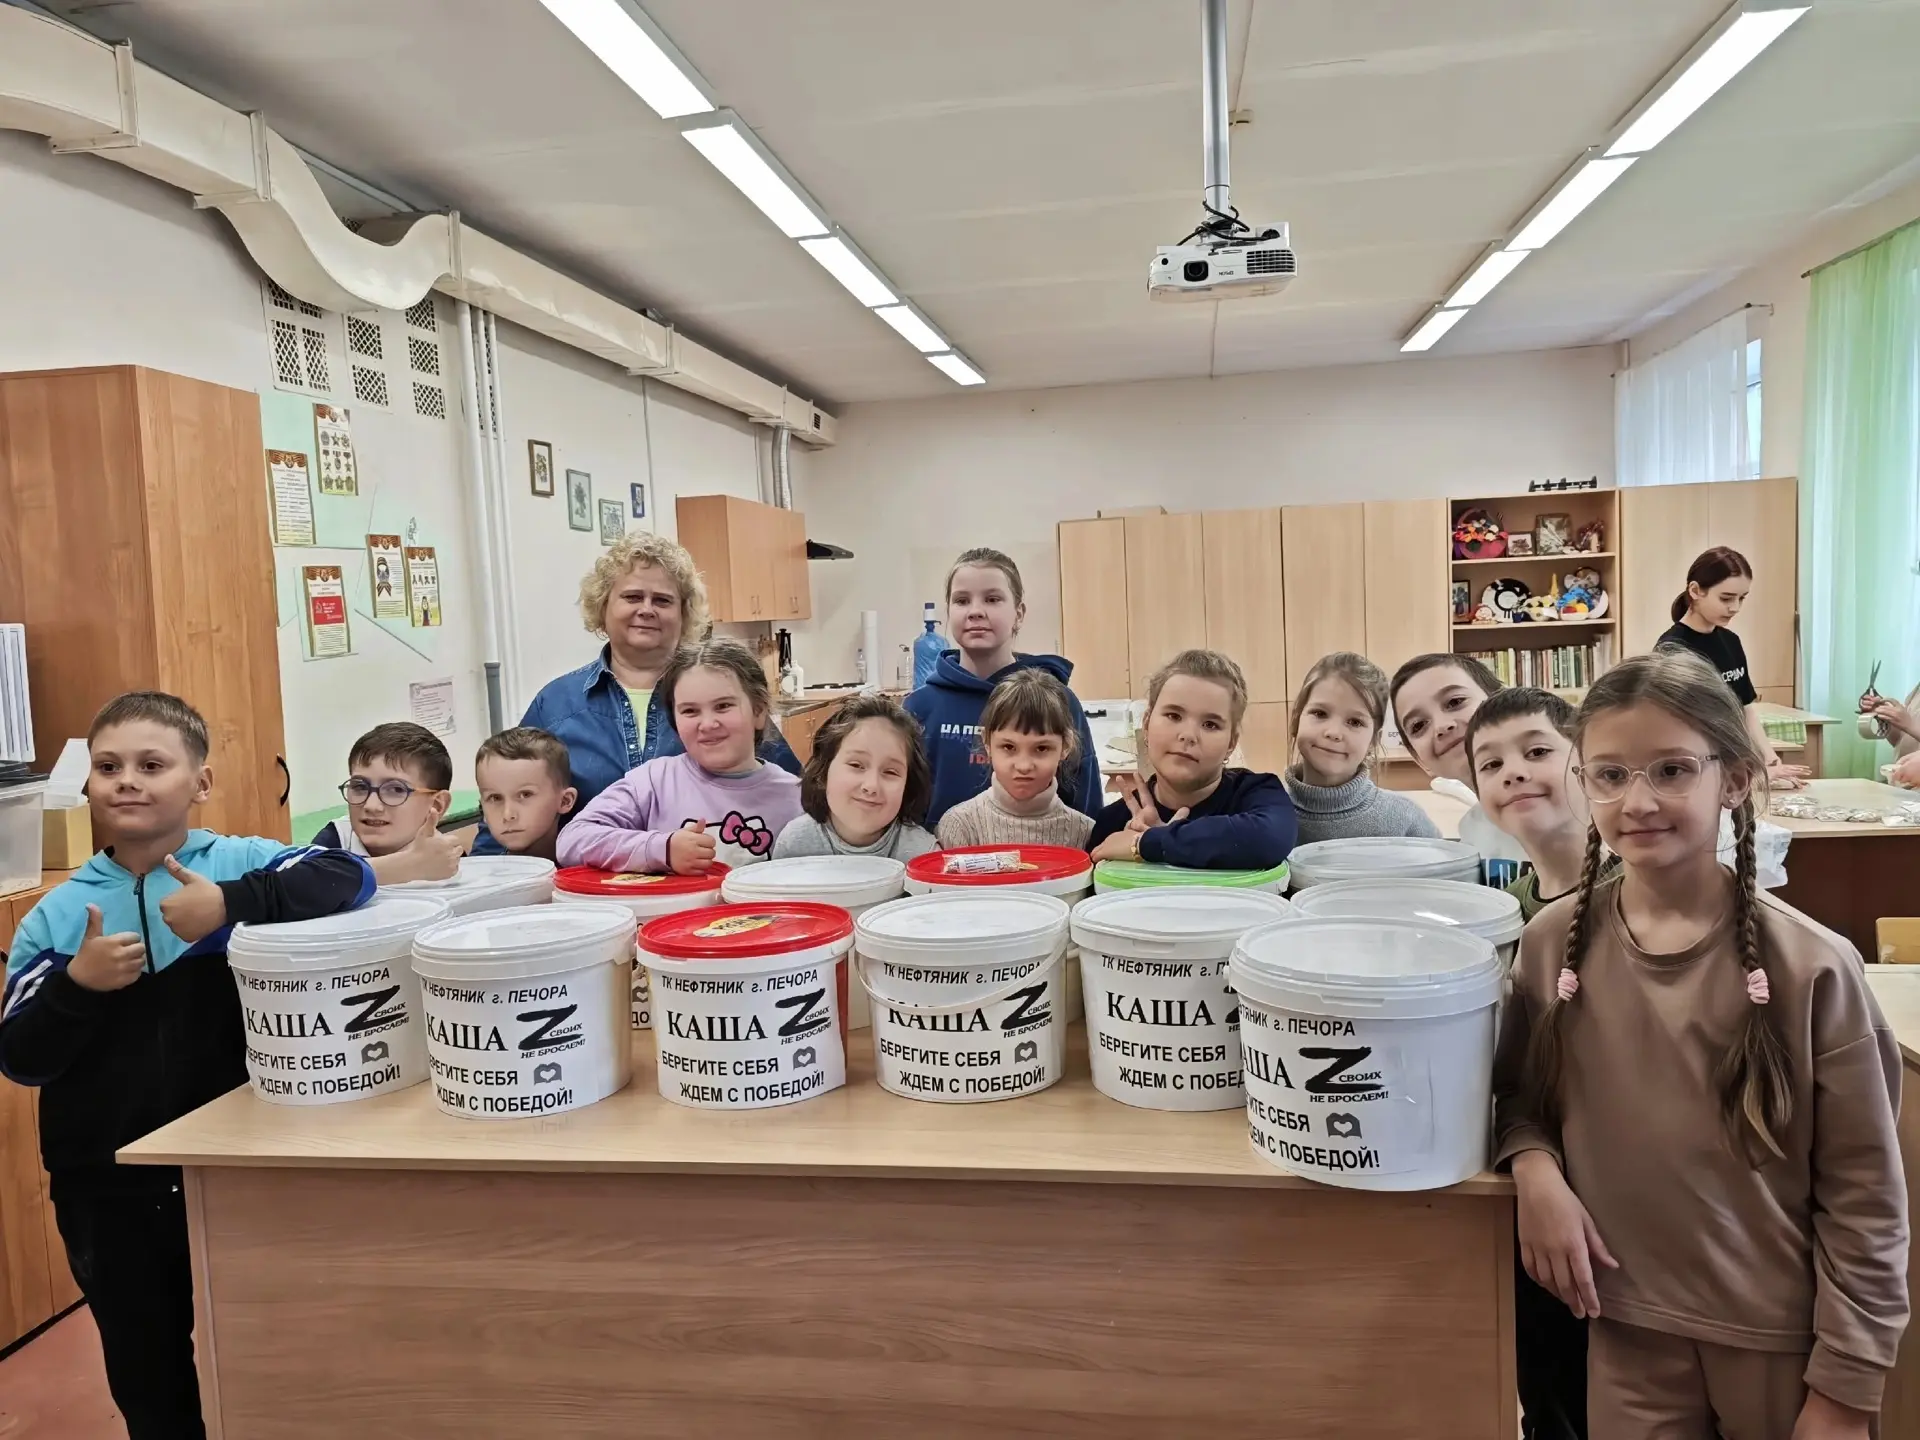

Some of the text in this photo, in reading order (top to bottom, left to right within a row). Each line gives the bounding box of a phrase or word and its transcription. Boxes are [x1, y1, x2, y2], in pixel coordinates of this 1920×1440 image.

[884, 963, 895, 976] ТК
[898, 966, 969, 984] НЕФТЯНИК
[1102, 955, 1115, 970] ТК
[1117, 960, 1193, 977] НЕФТЯНИК
[248, 977, 309, 992] НЕФТЯНИК
[331, 967, 390, 989] ПЕЧОРА
[429, 981, 486, 1003] НЕФТЯНИК
[508, 984, 568, 1003] ПЕЧОРА
[662, 975, 673, 989] ТК
[675, 978, 745, 994] НЕФТЯНИК
[767, 969, 818, 992] ПЕЧОРА
[374, 1001, 407, 1018] СВОИХ
[804, 1006, 830, 1022] СВОИХ
[1106, 991, 1216, 1027] КАША
[245, 1007, 335, 1037] КАША
[348, 1016, 410, 1041] НЕ БРОСАЕМ!
[426, 1011, 509, 1051] КАША
[549, 1023, 583, 1038] СВОИХ
[666, 1010, 768, 1042] КАША
[1003, 1029, 1016, 1038] НЕ
[1288, 1018, 1356, 1036] ПЕЧОРА
[521, 1038, 586, 1059] НЕ БРОСАЕМ!
[781, 1036, 793, 1045] НЕ
[880, 1037, 1001, 1067] БЕРЕГИТЕ СЕБЯ
[1099, 1031, 1226, 1063] БЕРЕГИТЕ СЕБЯ
[300, 1052, 347, 1070] СЕБЯ
[662, 1050, 779, 1076] БЕРЕГИТЕ СЕБЯ
[258, 1063, 401, 1096] ЖДЕМ С ПОБЕДОЙ!
[473, 1071, 518, 1086] СЕБЯ
[680, 1069, 824, 1103] ЖДЕМ С ПОБЕДОЙ!
[899, 1065, 1045, 1094] ЖДЕМ С ПОБЕДОЙ!
[1119, 1066, 1167, 1089] ЖДЕМ
[1172, 1074, 1184, 1090] С
[1338, 1071, 1382, 1083] СВОИХ
[436, 1083, 573, 1113] ЖДЕМ С ПОБЕДОЙ!
[1310, 1091, 1389, 1103] НЕ БРОСАЕМ!
[1268, 1105, 1311, 1133] СЕБЯ
[1268, 1135, 1276, 1154] С
[1279, 1139, 1380, 1171] ПОБЕДОЙ!
